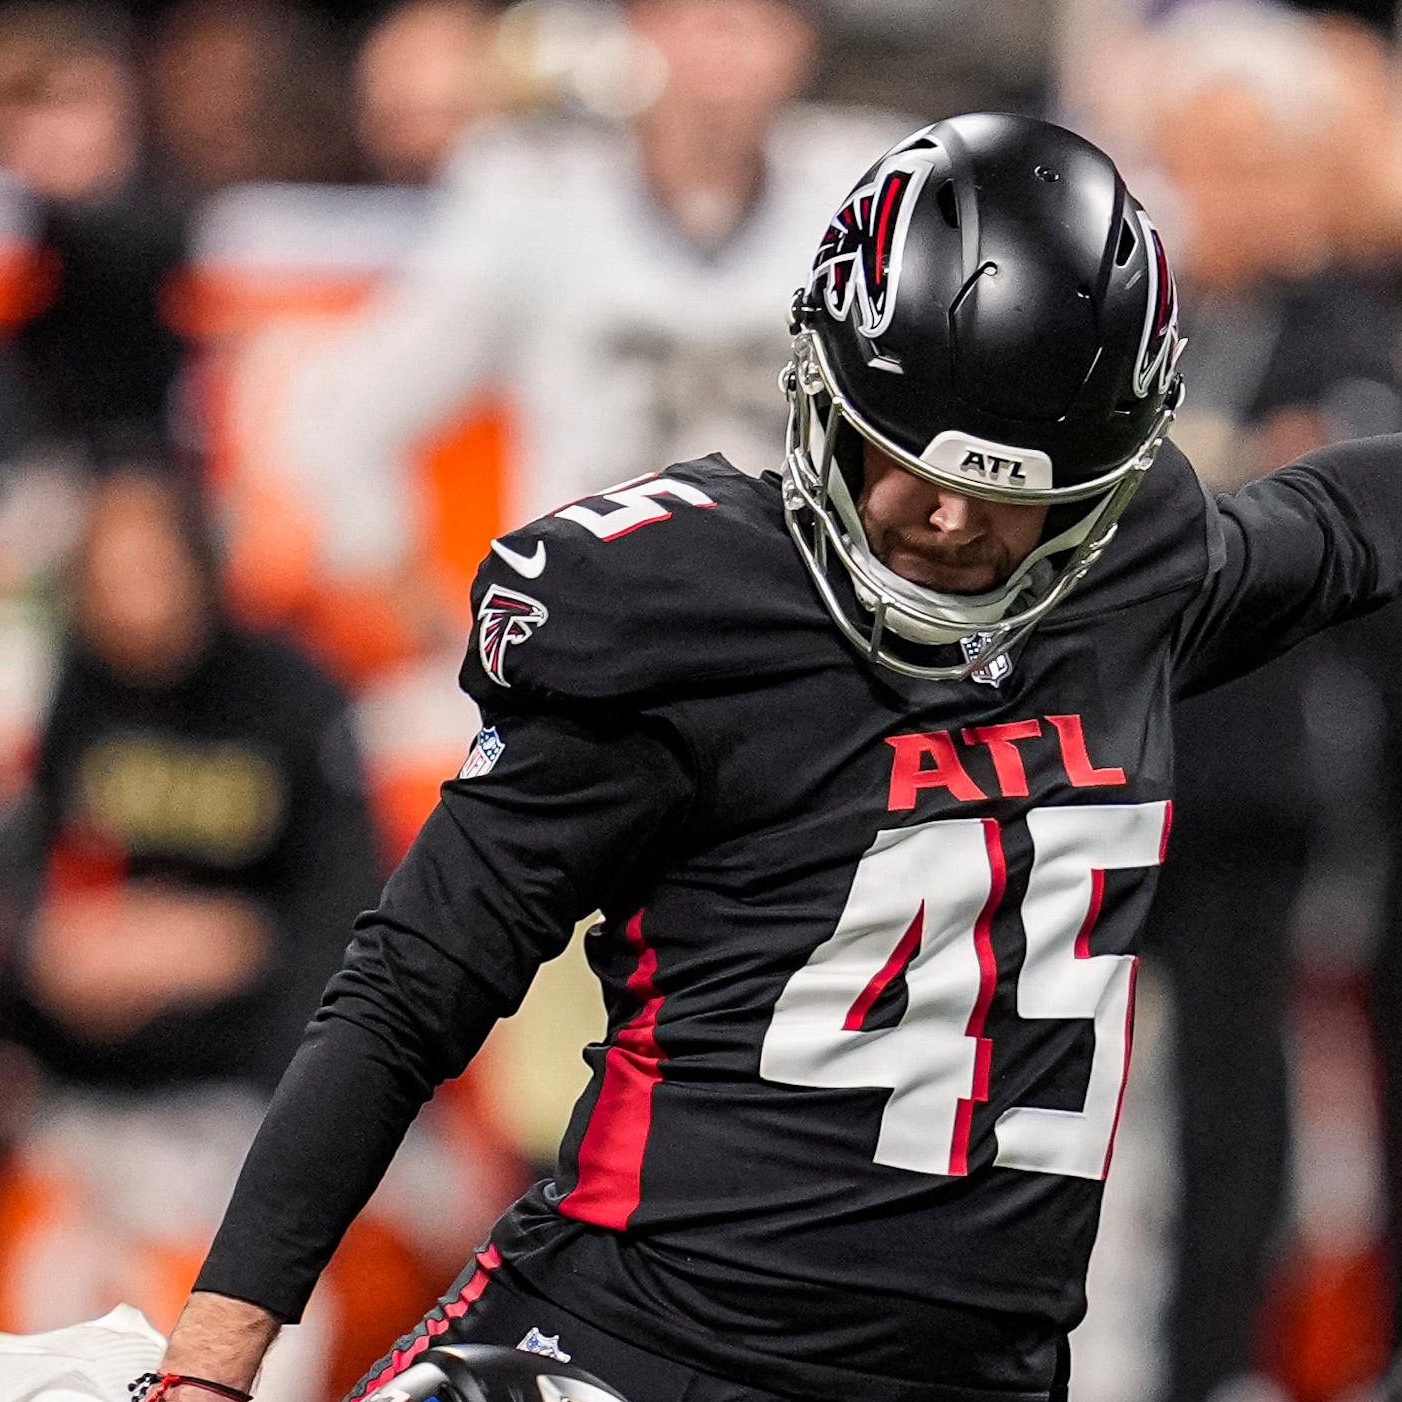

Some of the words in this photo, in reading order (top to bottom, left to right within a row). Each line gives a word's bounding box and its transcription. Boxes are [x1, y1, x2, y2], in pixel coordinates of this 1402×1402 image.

[543, 472, 718, 541] 5
[960, 449, 1026, 484] ATL
[884, 714, 1127, 811] ATL
[760, 800, 1173, 1180] 45
